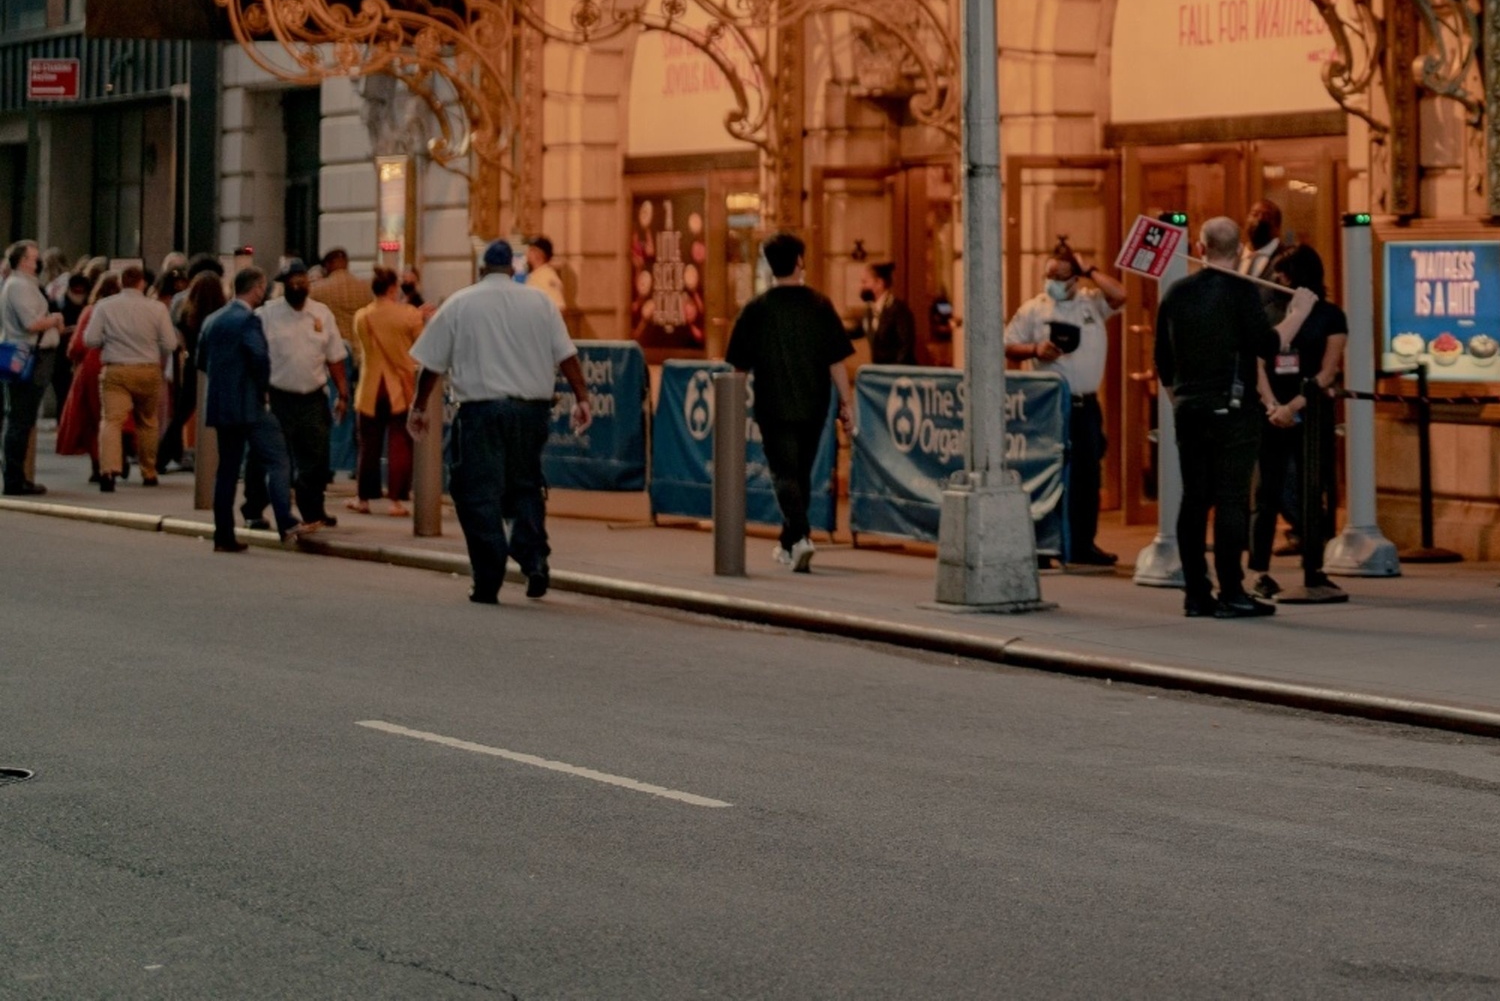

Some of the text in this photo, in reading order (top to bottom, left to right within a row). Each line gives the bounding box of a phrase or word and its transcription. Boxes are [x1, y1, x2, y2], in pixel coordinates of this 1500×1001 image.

[1179, 3, 1214, 46] FALL
[1415, 280, 1432, 317] IS
[1433, 281, 1446, 316] A
[921, 380, 1027, 422] The Sert
